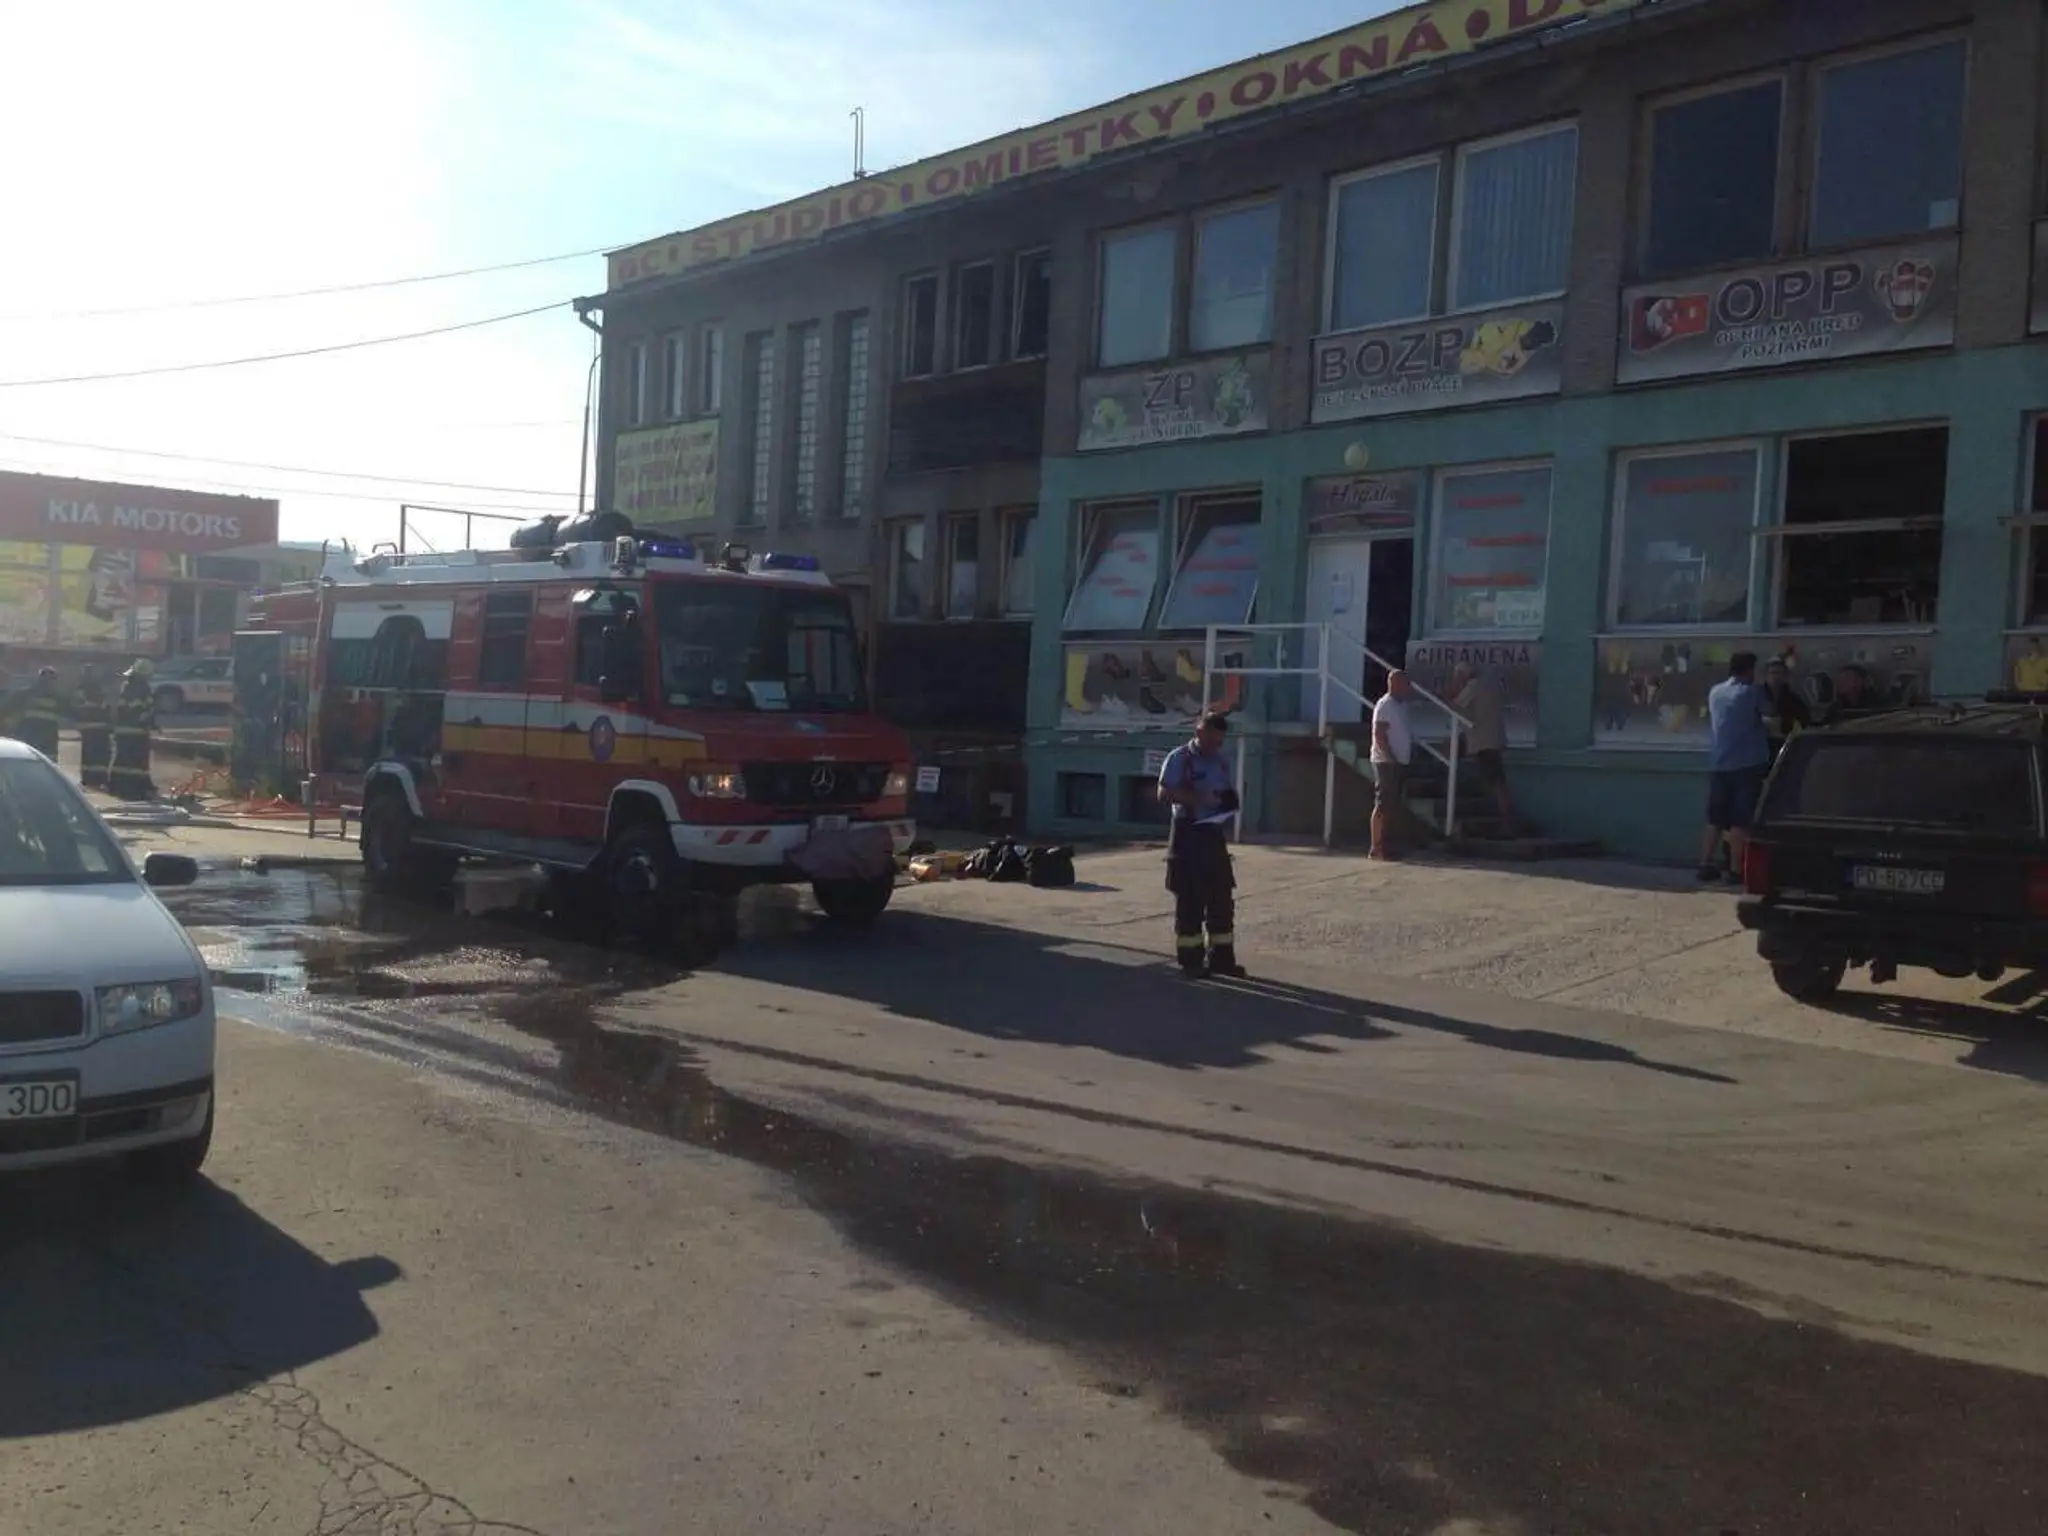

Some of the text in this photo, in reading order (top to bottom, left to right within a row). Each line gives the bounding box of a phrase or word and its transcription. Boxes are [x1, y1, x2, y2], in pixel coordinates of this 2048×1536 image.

[691, 185, 887, 259] STUDIO
[926, 97, 1187, 196] OMIETKY
[1229, 11, 1449, 105] OKNÁ
[1716, 263, 1862, 325] OPP
[1317, 328, 1464, 385] BOZP
[49, 499, 241, 538] KIA MOTORS
